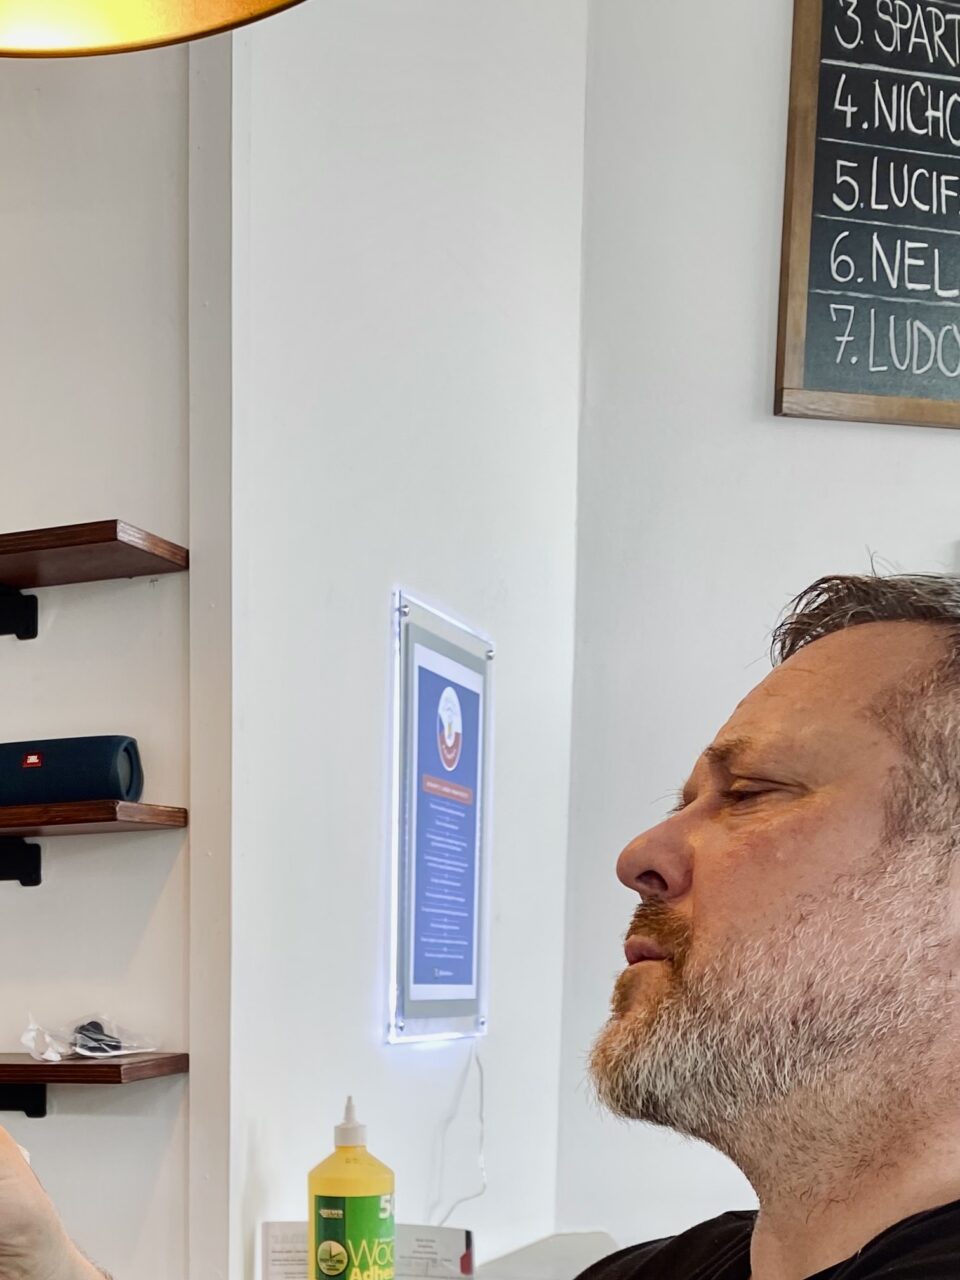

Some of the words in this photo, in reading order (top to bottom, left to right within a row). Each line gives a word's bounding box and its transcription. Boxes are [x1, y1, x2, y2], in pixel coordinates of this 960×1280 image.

[874, 0, 960, 68] SPART
[871, 156, 960, 215] LUCIF
[872, 232, 960, 298] NEL
